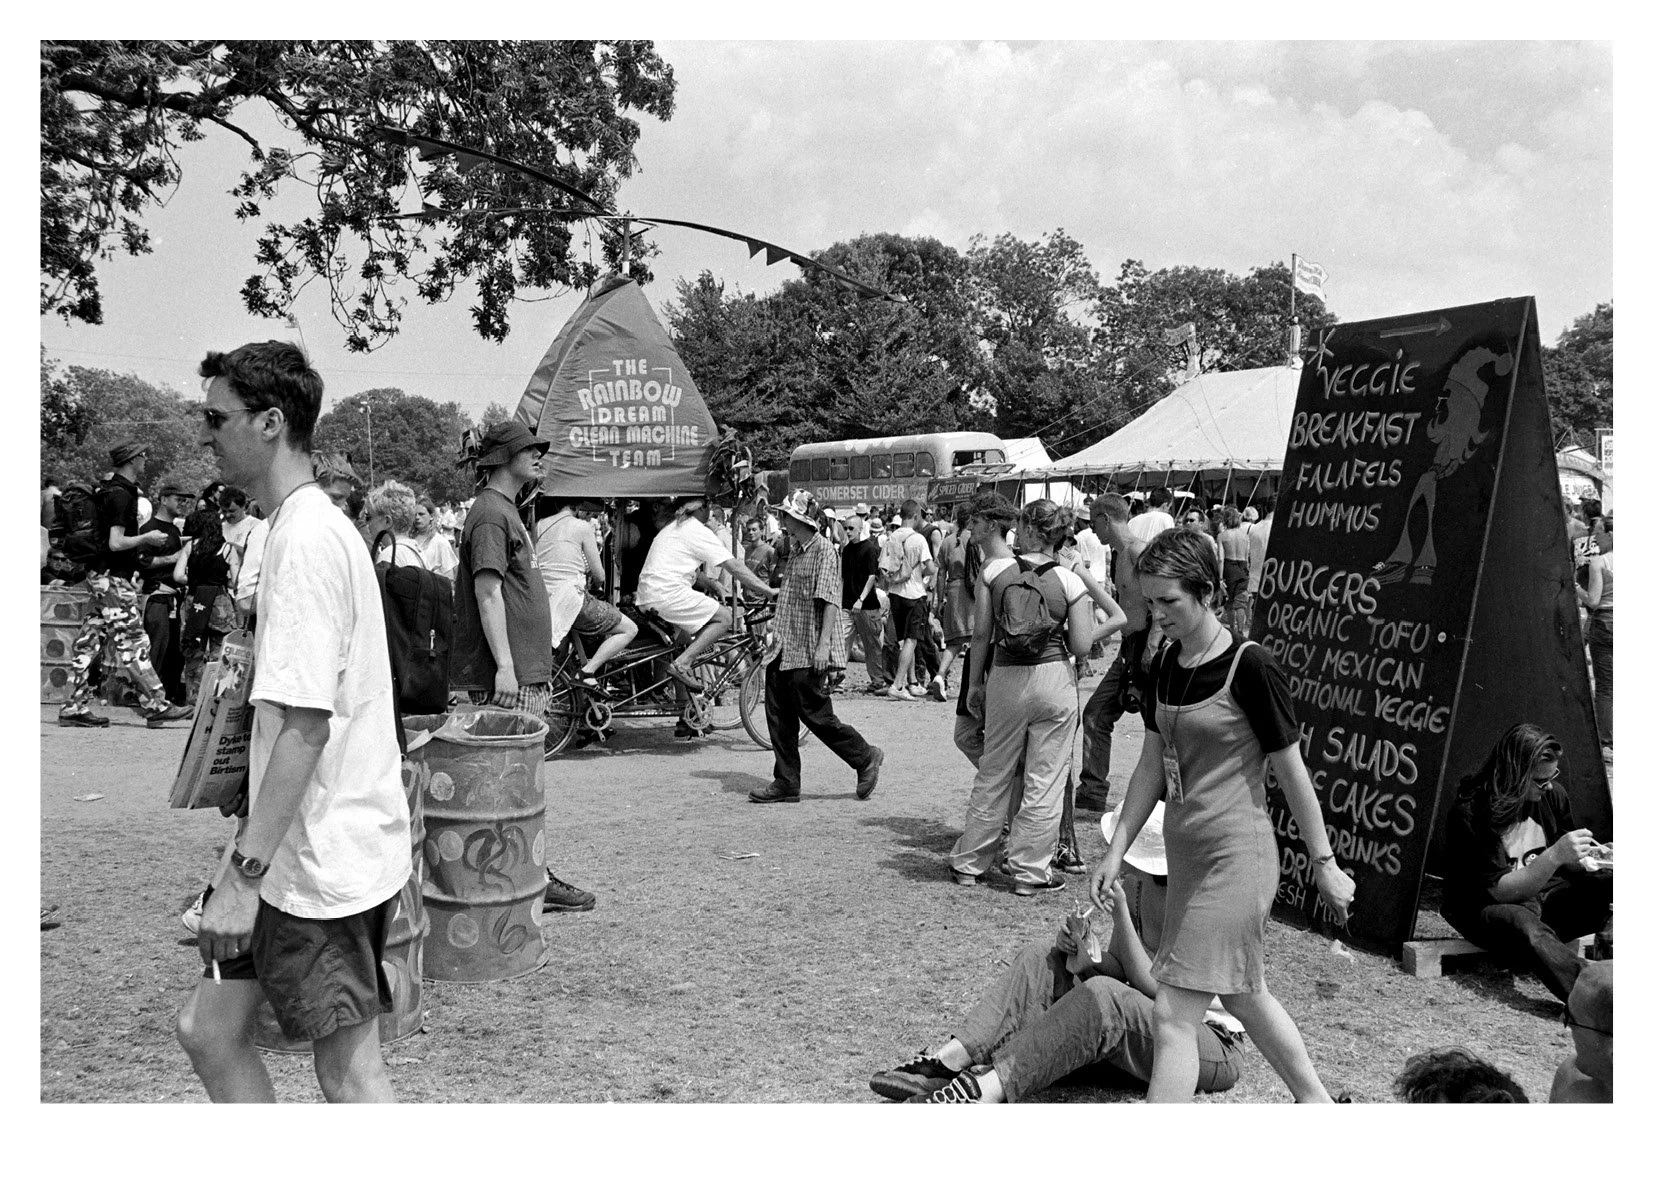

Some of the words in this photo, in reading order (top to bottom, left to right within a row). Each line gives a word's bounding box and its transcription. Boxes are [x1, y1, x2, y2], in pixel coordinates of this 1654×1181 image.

[612, 358, 648, 376] THE
[1317, 349, 1420, 399] VEGGIE
[577, 379, 683, 411] RAINBOW
[598, 405, 667, 424] DREAM
[1288, 412, 1421, 449] BREAKFAST
[569, 425, 620, 447] CLEAN
[626, 425, 699, 446] MACHINE
[609, 449, 662, 468] TEAM
[816, 485, 868, 500] SOMERSET
[872, 483, 905, 499] CIDER
[957, 482, 975, 495] CIDER
[1296, 459, 1402, 494] FALAFELS
[1287, 500, 1382, 533] HUMMUS
[1259, 557, 1381, 614] BURGERS
[1267, 601, 1354, 642] ORGANIC
[1367, 615, 1430, 653] TOFU
[1321, 648, 1425, 692] MEXICAN
[1289, 670, 1366, 716] DITIONAL
[1374, 689, 1450, 733] VEGGIE
[216, 745, 246, 756] stamp
[219, 734, 242, 747] Dyke
[1323, 727, 1418, 785] SALADS
[209, 765, 246, 776] Birtism
[213, 756, 230, 766] out
[1329, 778, 1417, 836] CAKES
[1325, 824, 1401, 876] DRINKS
